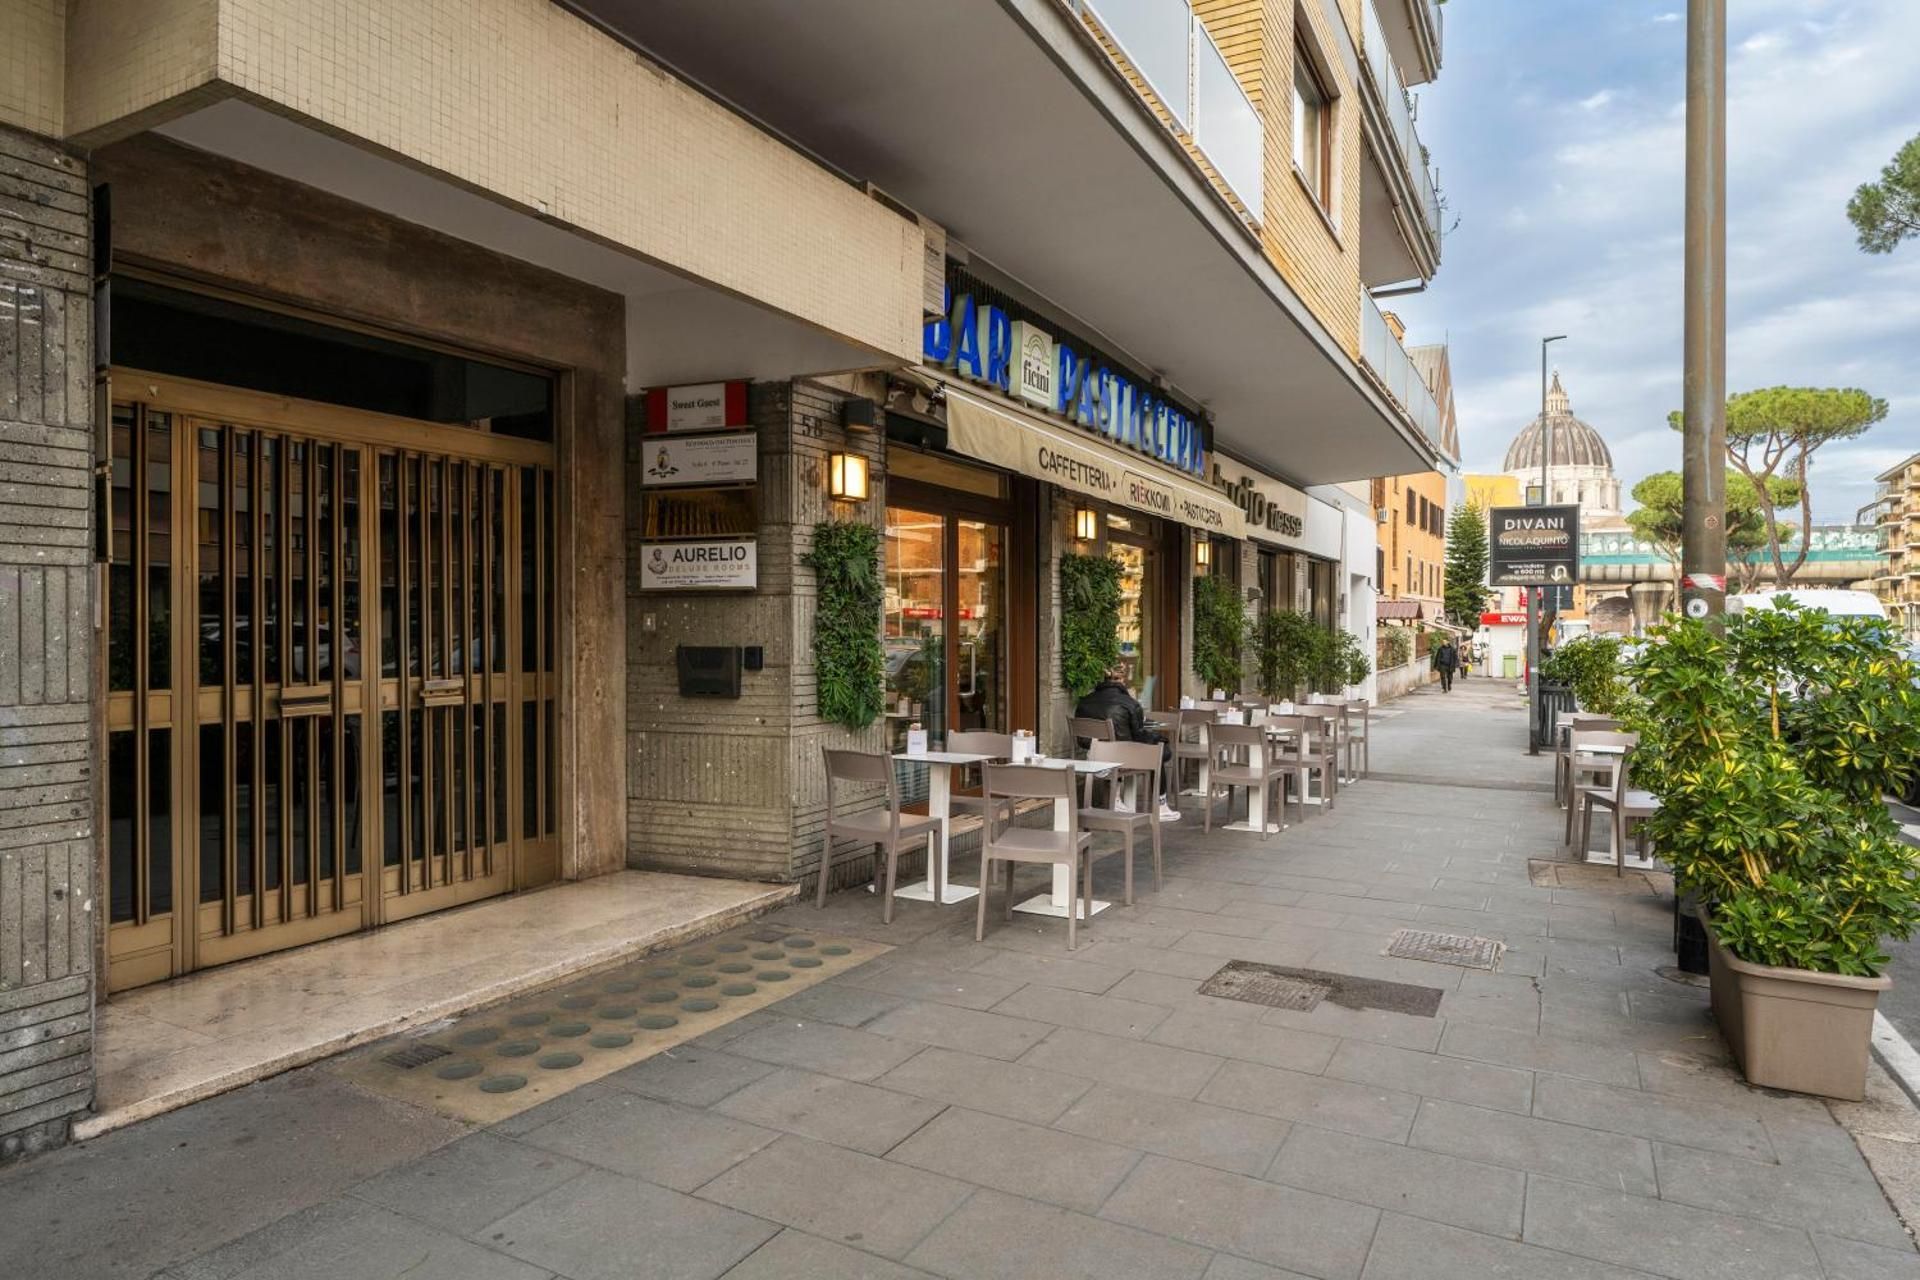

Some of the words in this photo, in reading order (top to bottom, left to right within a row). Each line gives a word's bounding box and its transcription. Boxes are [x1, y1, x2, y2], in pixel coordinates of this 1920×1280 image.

[1023, 360, 1050, 394] ficini
[671, 400, 695, 410] Sweet
[1058, 344, 1205, 480] PASTICCERIA
[1038, 447, 1111, 493] CAFFETTERIA
[1504, 517, 1564, 530] DIVANI
[1499, 535, 1569, 546] NICOLAQUINTO
[673, 546, 747, 563] AURELIO
